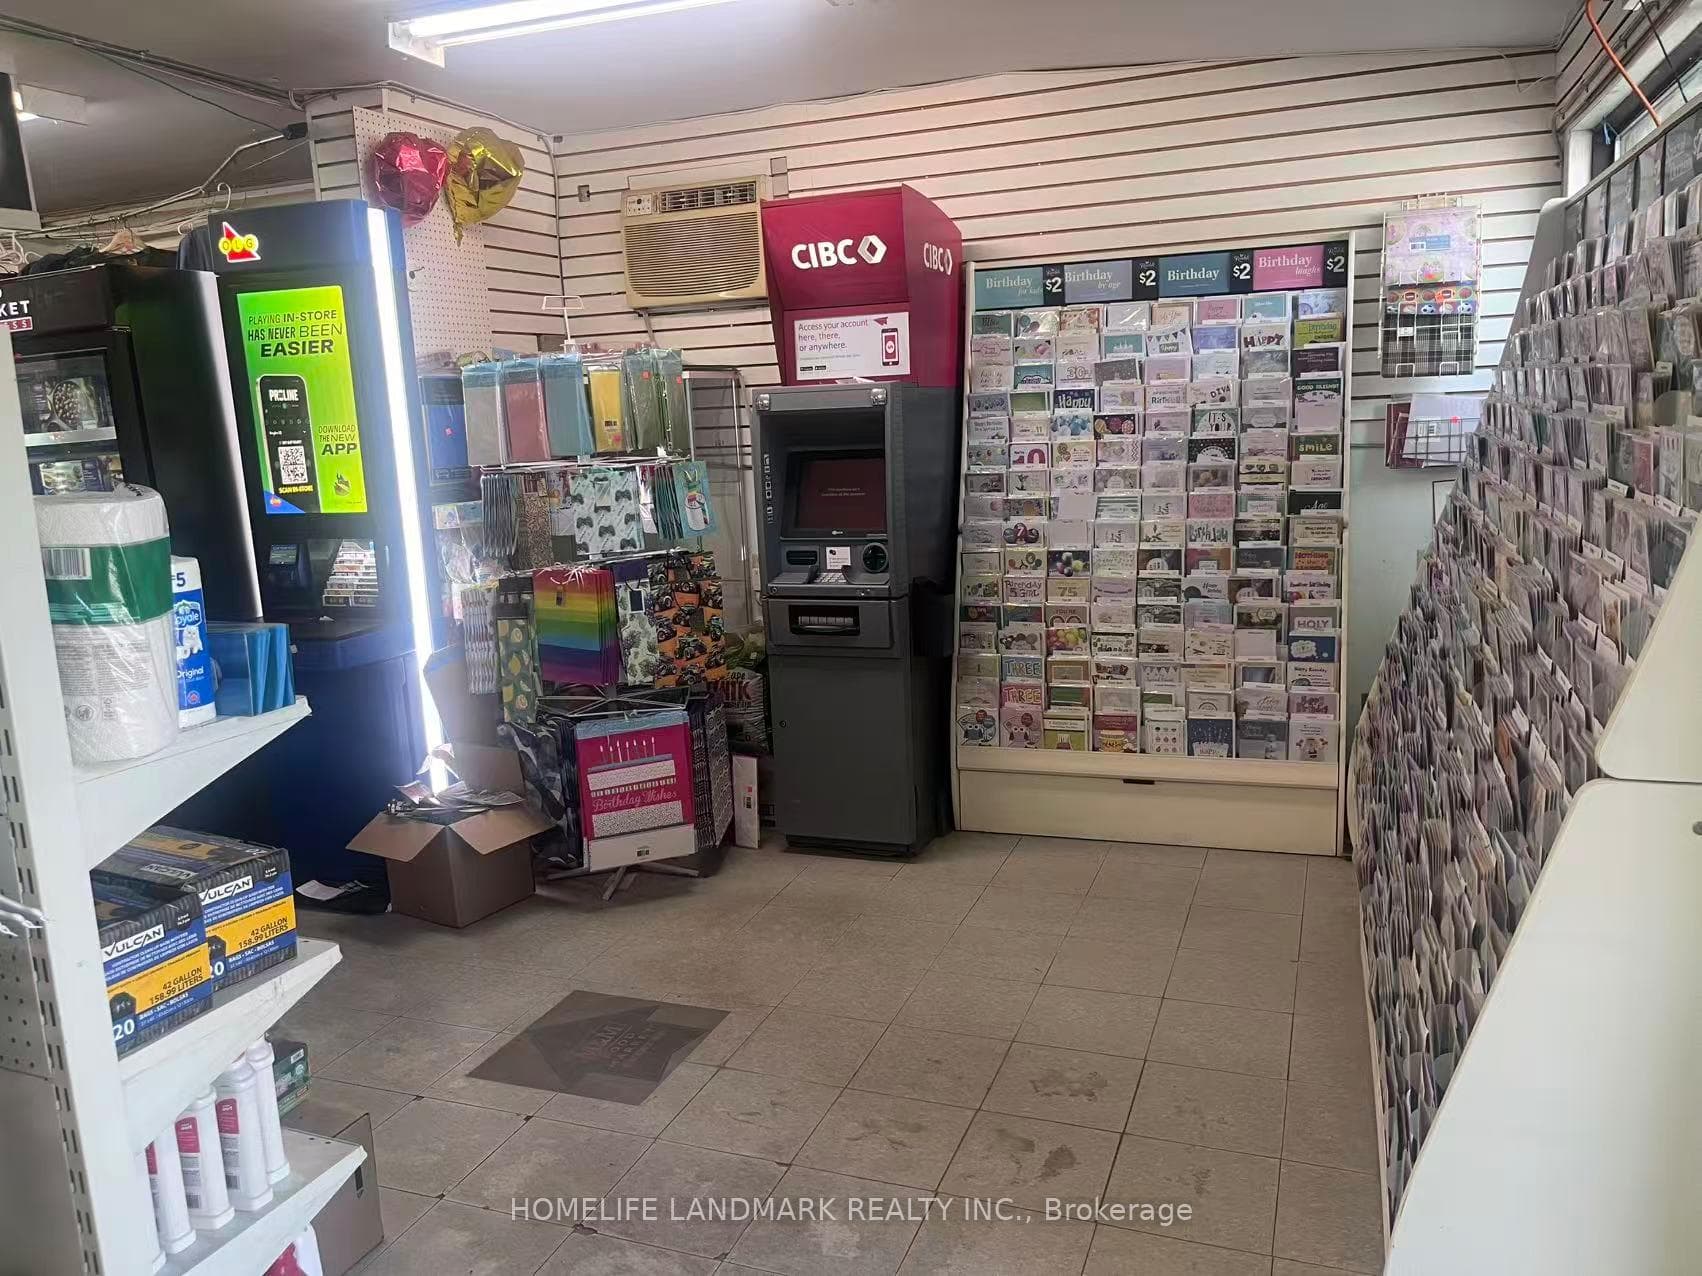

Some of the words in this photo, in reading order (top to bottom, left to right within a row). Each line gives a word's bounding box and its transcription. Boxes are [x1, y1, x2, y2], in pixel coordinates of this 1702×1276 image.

[791, 239, 857, 269] CIBC
[923, 242, 945, 274] CIBC
[1258, 253, 1313, 269] Birthday
[1232, 262, 1250, 280] $2
[1326, 256, 1345, 273] $2
[985, 276, 1033, 289] Birthday
[1065, 269, 1113, 283] Birthday
[1139, 269, 1156, 287] $2
[1167, 267, 1220, 282] Birthday
[1045, 276, 1062, 293] $2
[249, 315, 280, 325] PLAYING
[283, 310, 337, 322] IN-STORE
[798, 323, 822, 331] Access
[823, 322, 839, 331] your
[840, 319, 868, 328] account
[248, 328, 265, 341] HAS
[268, 326, 296, 340] NEVER
[300, 323, 343, 338] BEEN
[799, 334, 816, 342] here,
[261, 339, 334, 358] EASIER
[808, 341, 848, 352] anywhere.
[1210, 384, 1231, 398] DIVA
[318, 424, 356, 434] DOWNLOAD
[320, 434, 330, 442] THE
[331, 433, 356, 442] NEW
[321, 442, 358, 456] APP
[1057, 586, 1078, 597] 75
[176, 611, 200, 628] oyale
[1297, 620, 1329, 629] HOLY
[1004, 659, 1041, 677] THREE
[1003, 687, 1041, 703] THREE
[592, 793, 641, 812] Birthday
[250, 928, 259, 937] 42
[260, 916, 288, 933] GALLON
[104, 926, 162, 957] VULCAN
[238, 933, 264, 949] 158.99
[265, 924, 289, 939] LITERS
[162, 979, 172, 990] 42
[173, 966, 202, 985] GALLON
[150, 987, 177, 1004] 158.99
[177, 975, 203, 993] LITERS
[113, 1019, 135, 1041] 20
